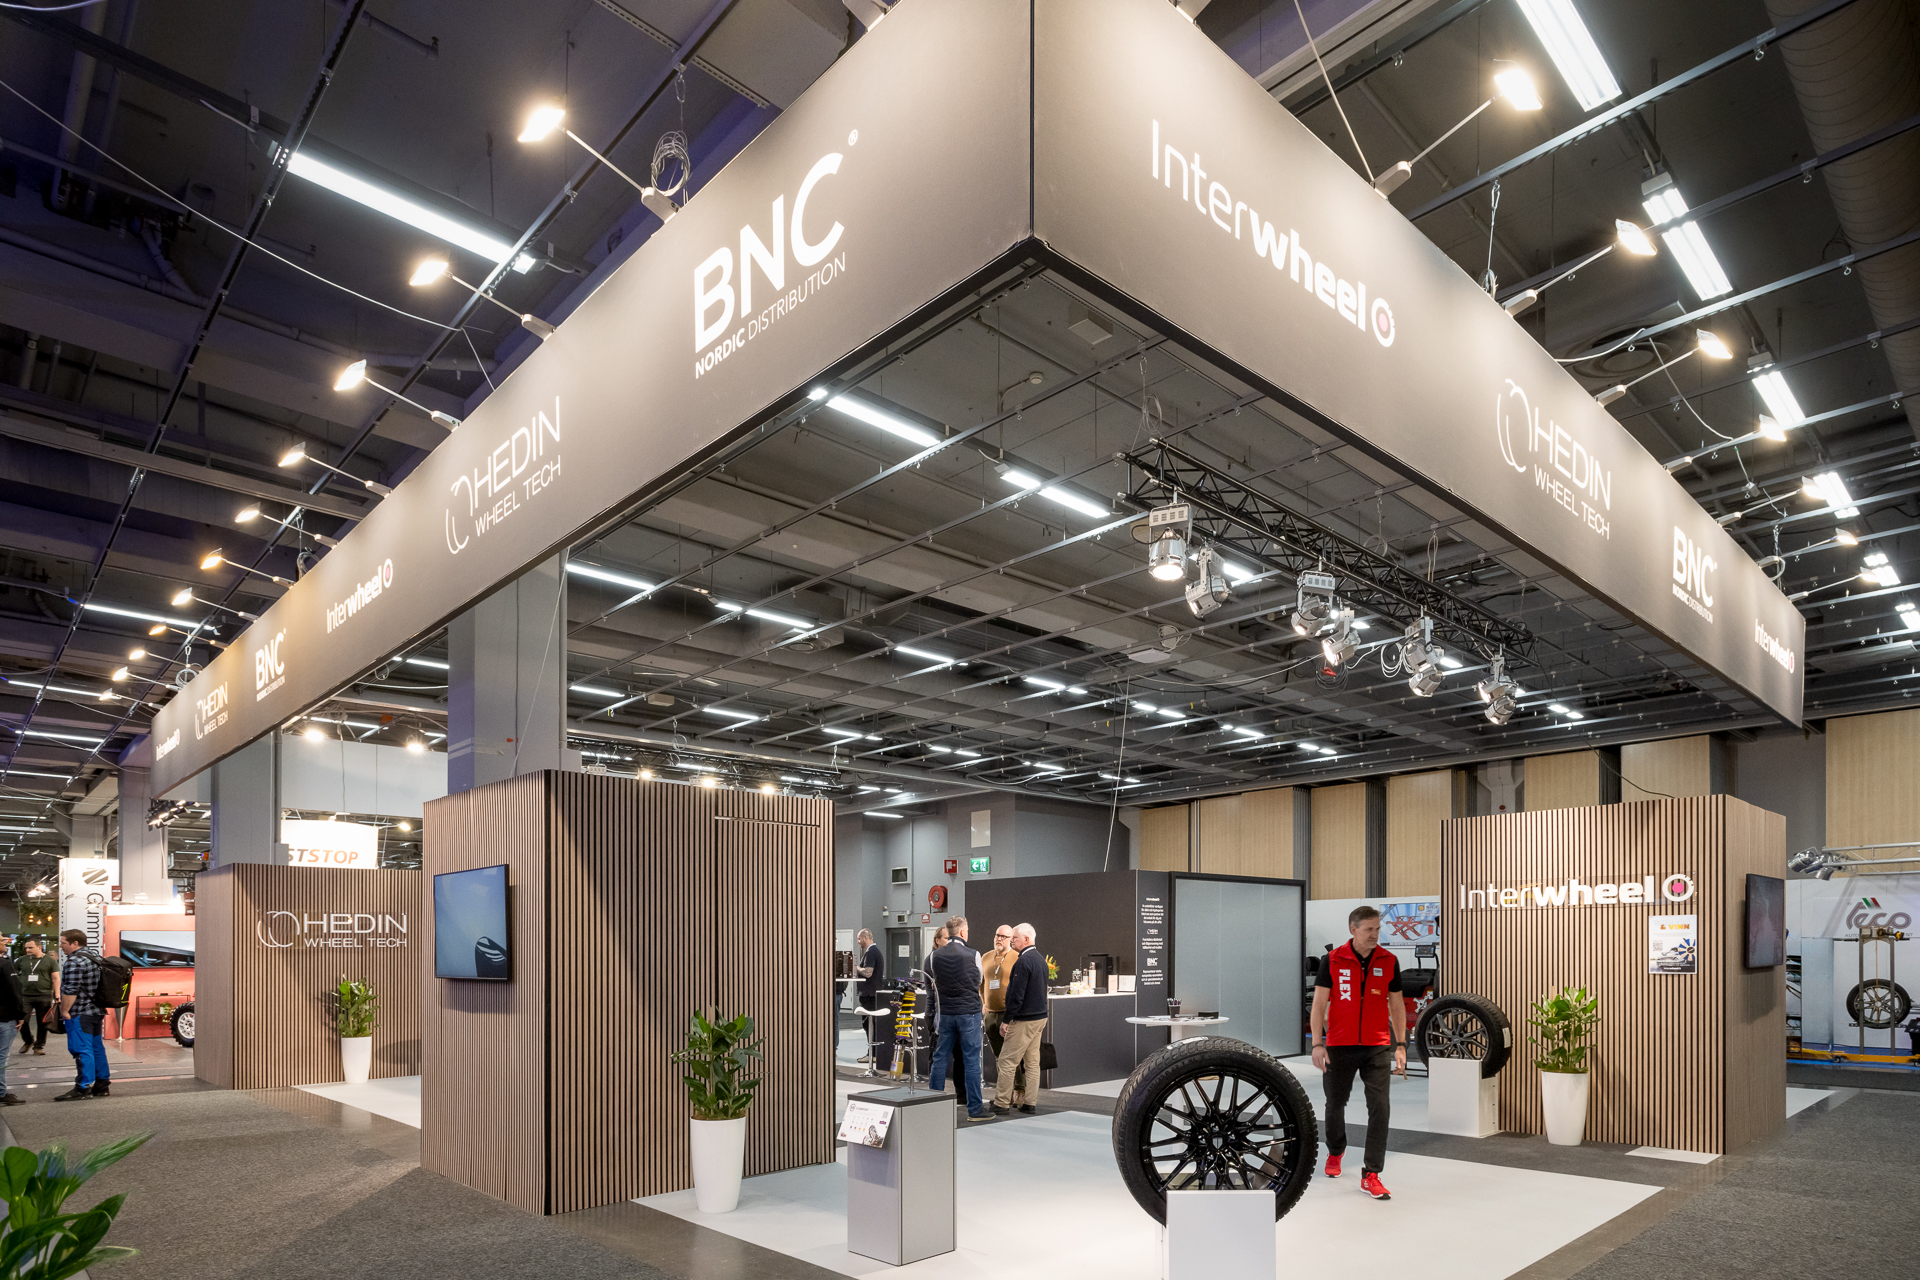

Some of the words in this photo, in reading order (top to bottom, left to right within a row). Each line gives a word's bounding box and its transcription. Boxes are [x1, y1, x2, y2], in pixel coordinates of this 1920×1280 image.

[1153, 119, 1366, 332] Interwheel
[695, 328, 745, 379] NORDIC
[748, 252, 846, 340] DISTRIBUTION
[474, 395, 560, 508] HEDIN
[1535, 407, 1611, 510] HEDIN
[475, 491, 520, 537] WHEEL
[523, 455, 561, 500] TECH
[1534, 464, 1578, 516] WHEEL
[1581, 501, 1610, 540] TECH
[327, 565, 382, 634] Interwheel
[203, 681, 228, 721] HEDIN
[303, 913, 407, 934] HEDIN
[1460, 875, 1655, 910] Interwheel
[304, 938, 363, 948] WHEEL
[367, 938, 407, 948] TECH
[1339, 968, 1351, 1001] FLEX
